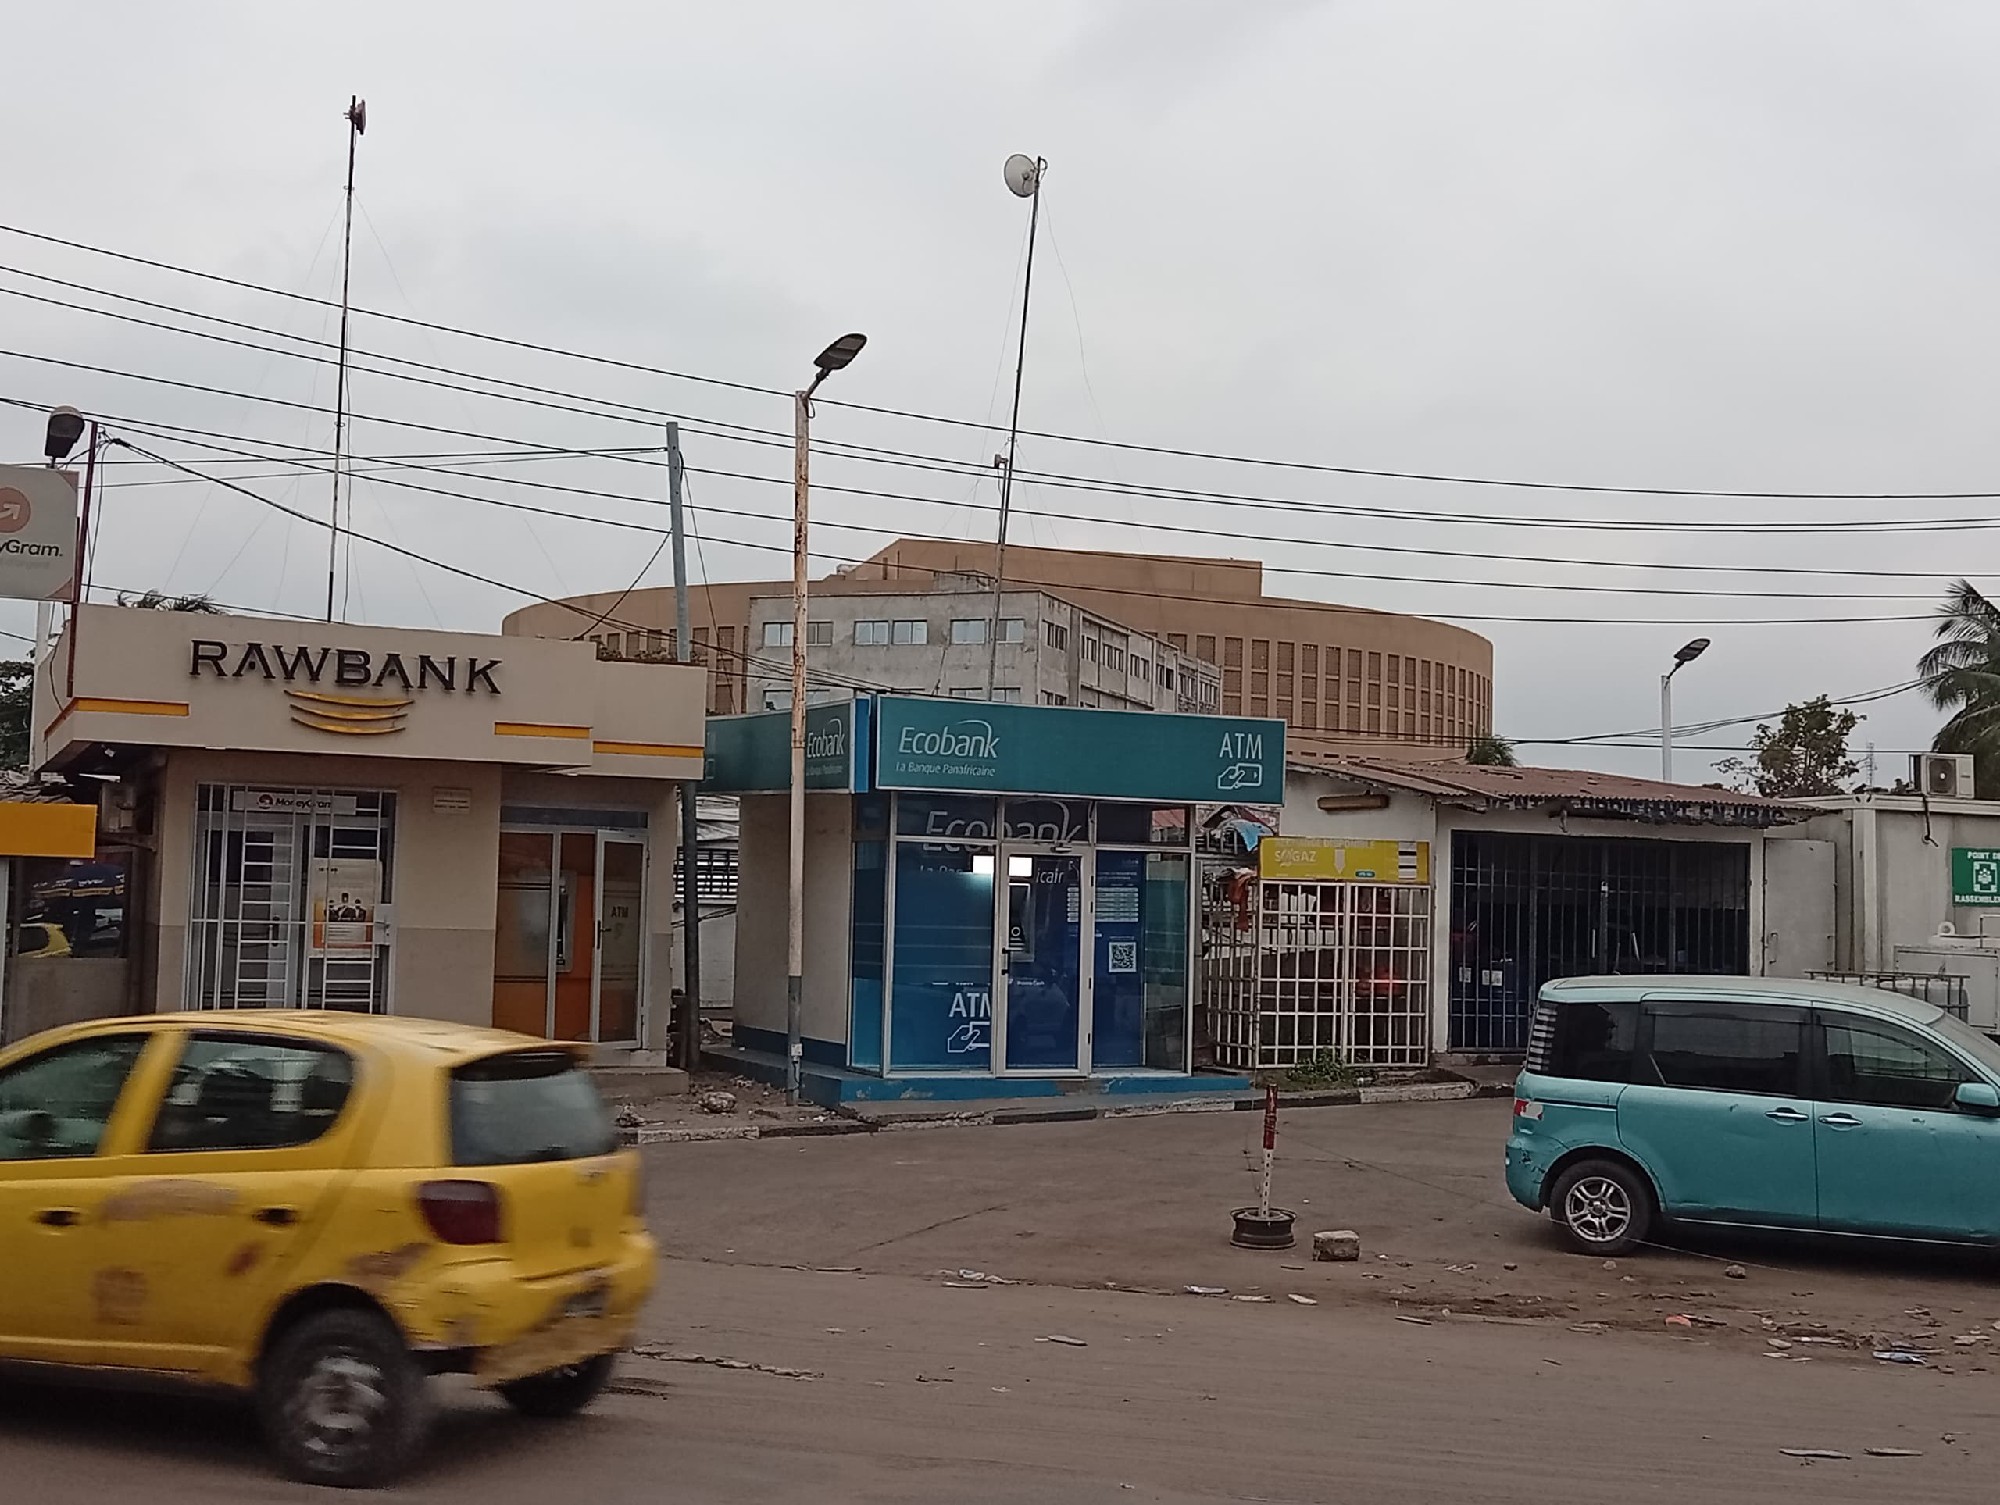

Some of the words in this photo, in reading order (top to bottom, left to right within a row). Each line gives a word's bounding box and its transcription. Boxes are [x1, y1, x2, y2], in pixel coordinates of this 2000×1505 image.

[190, 638, 502, 694] RAWBANK
[806, 718, 846, 758] Ecobank
[898, 719, 1001, 759] Ecobank
[1219, 732, 1263, 760] ATM
[908, 762, 941, 776] Banque
[943, 763, 996, 777] Panafricaine
